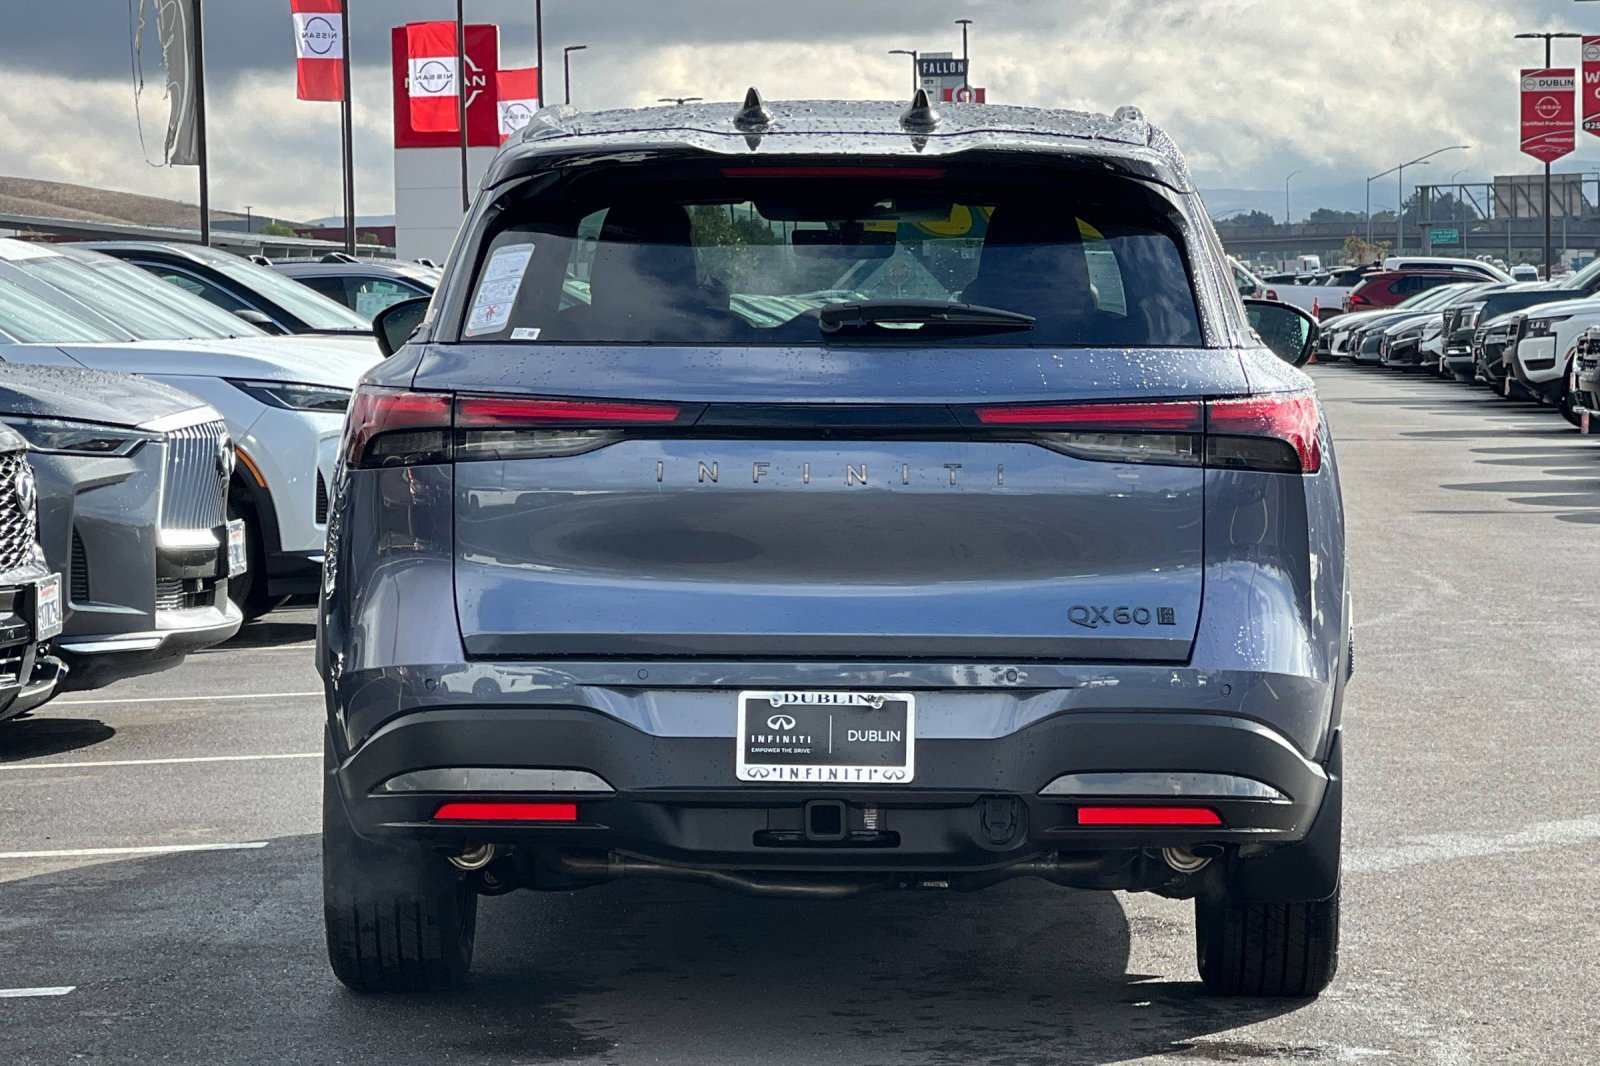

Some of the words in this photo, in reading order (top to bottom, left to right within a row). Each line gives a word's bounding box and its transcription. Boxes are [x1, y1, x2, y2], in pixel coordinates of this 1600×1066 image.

[923, 61, 964, 74] FALLON
[656, 461, 1004, 486] INFINITI
[1067, 604, 1151, 629] QX60
[751, 734, 811, 744] INFINITI
[847, 730, 901, 742] DUBLIN
[779, 767, 873, 780] INFINITI
